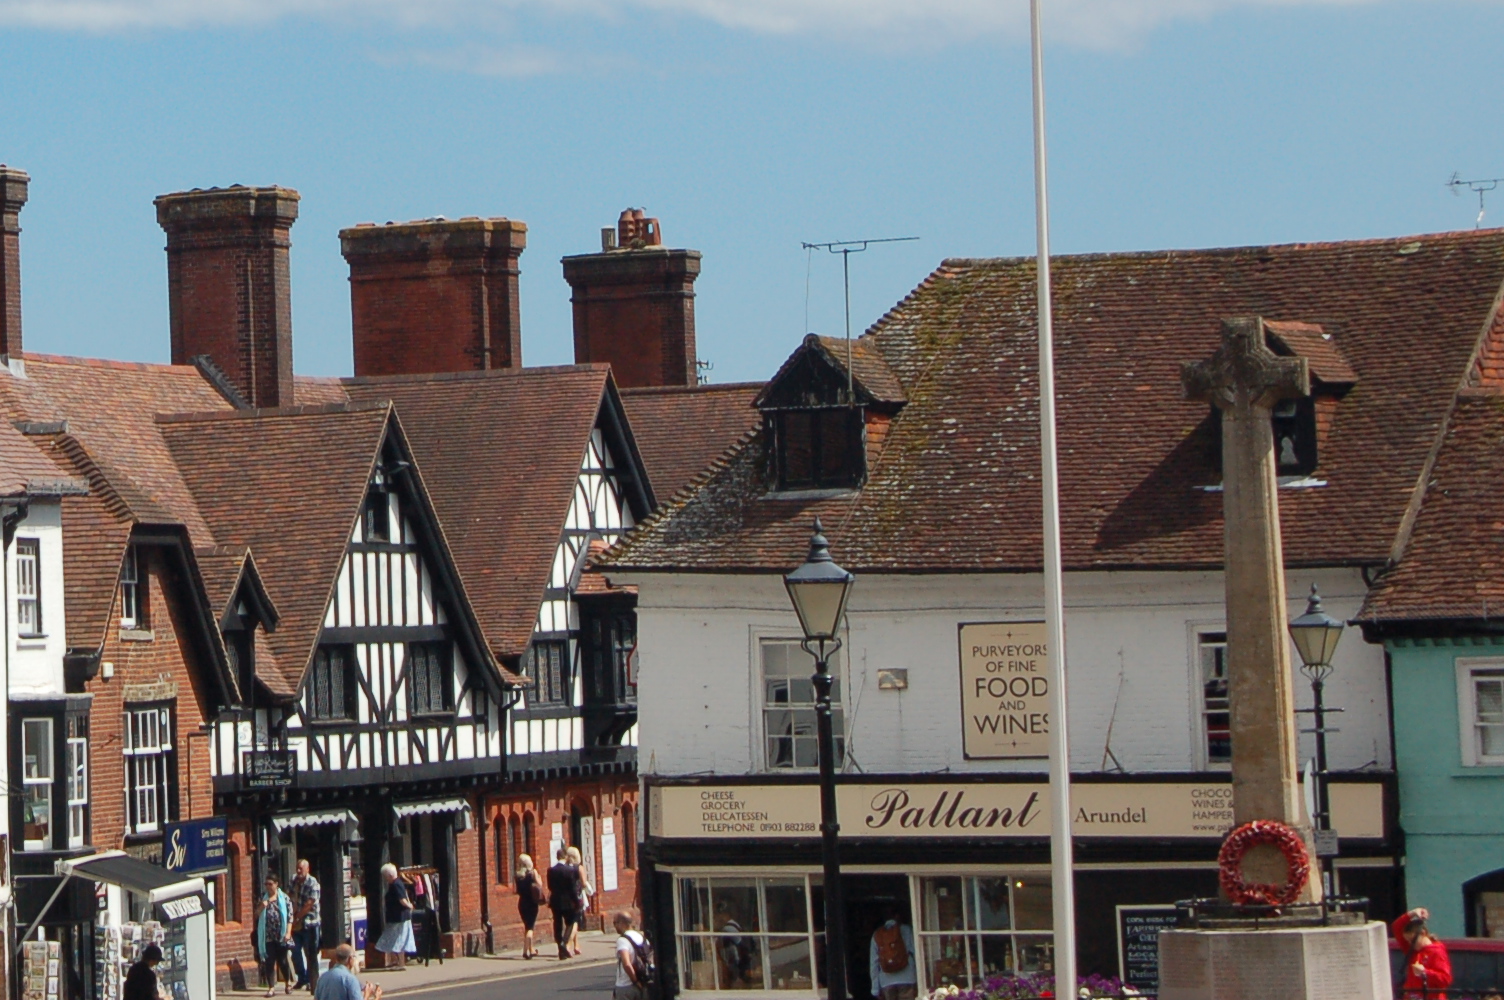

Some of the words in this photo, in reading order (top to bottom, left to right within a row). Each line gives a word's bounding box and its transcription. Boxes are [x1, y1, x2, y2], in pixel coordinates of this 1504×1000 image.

[985, 661, 1004, 673] OF
[1008, 660, 1037, 672] FINE
[975, 676, 1047, 698] FOOD
[998, 700, 1026, 711] AND
[973, 713, 1049, 735] WINES
[700, 791, 735, 800] CHEESE
[1191, 788, 1232, 798] CHOCO
[701, 801, 746, 810] GROCERY
[865, 788, 1041, 829] Pallant
[1074, 807, 1147, 824] Arundel
[1191, 800, 1225, 809] WINES
[702, 812, 768, 821] DELICATESSEN
[1192, 811, 1234, 820] HAMPER
[701, 823, 755, 832] TELEPHONE
[760, 823, 782, 832] 01903
[784, 823, 816, 832] 882288
